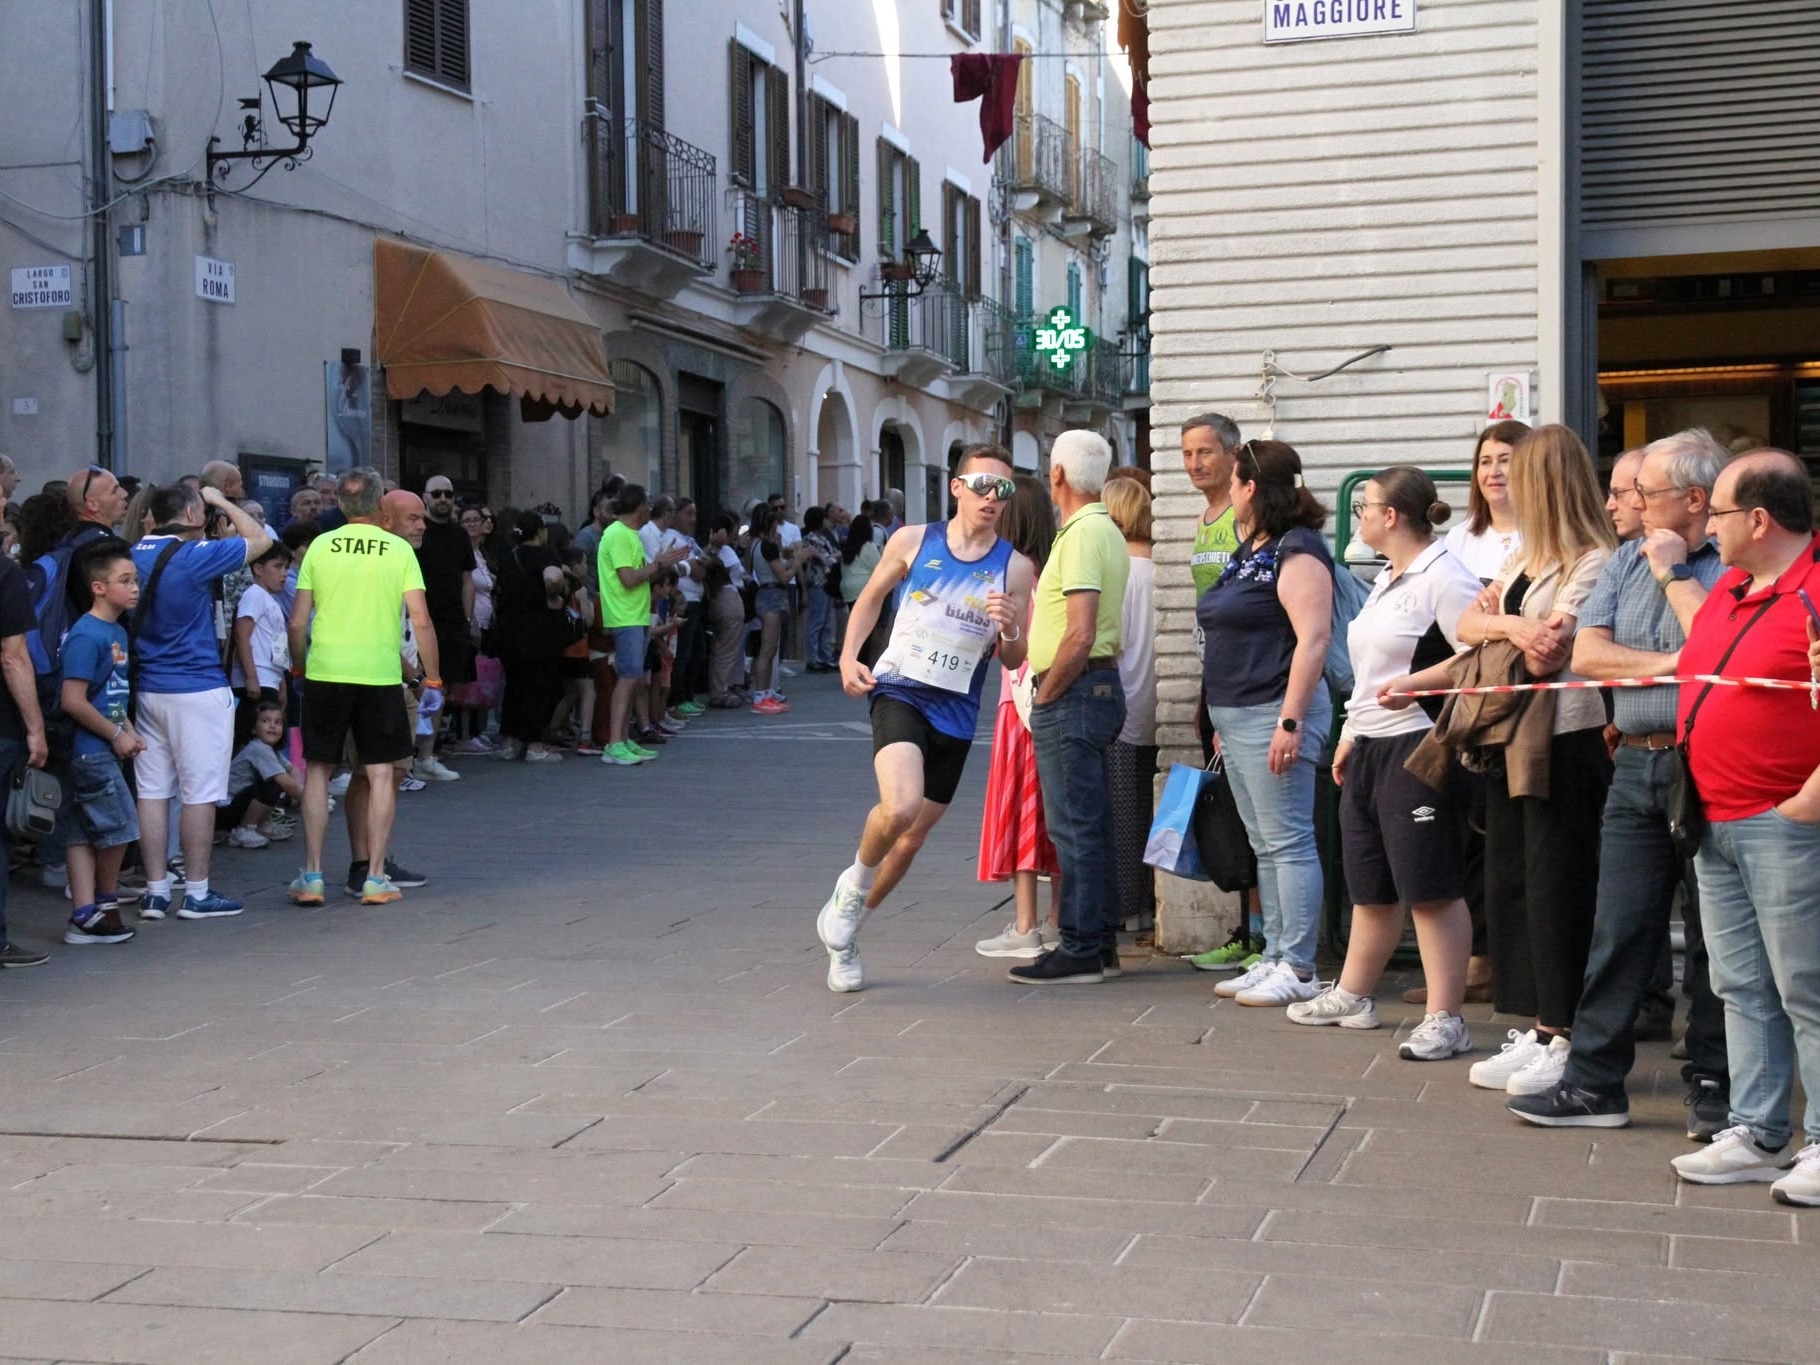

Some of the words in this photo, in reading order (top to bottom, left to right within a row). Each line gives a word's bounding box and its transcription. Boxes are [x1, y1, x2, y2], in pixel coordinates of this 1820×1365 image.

[1273, 0, 1403, 28] MAGGIORE
[27, 268, 54, 279] LARGO
[207, 263, 223, 276] VIA
[32, 279, 49, 289] SAN
[202, 278, 229, 299] ROMA
[13, 290, 70, 305] CRISTOFORO
[1036, 329, 1085, 350] 30/05
[330, 537, 390, 556] STAFF
[927, 650, 960, 671] 419
